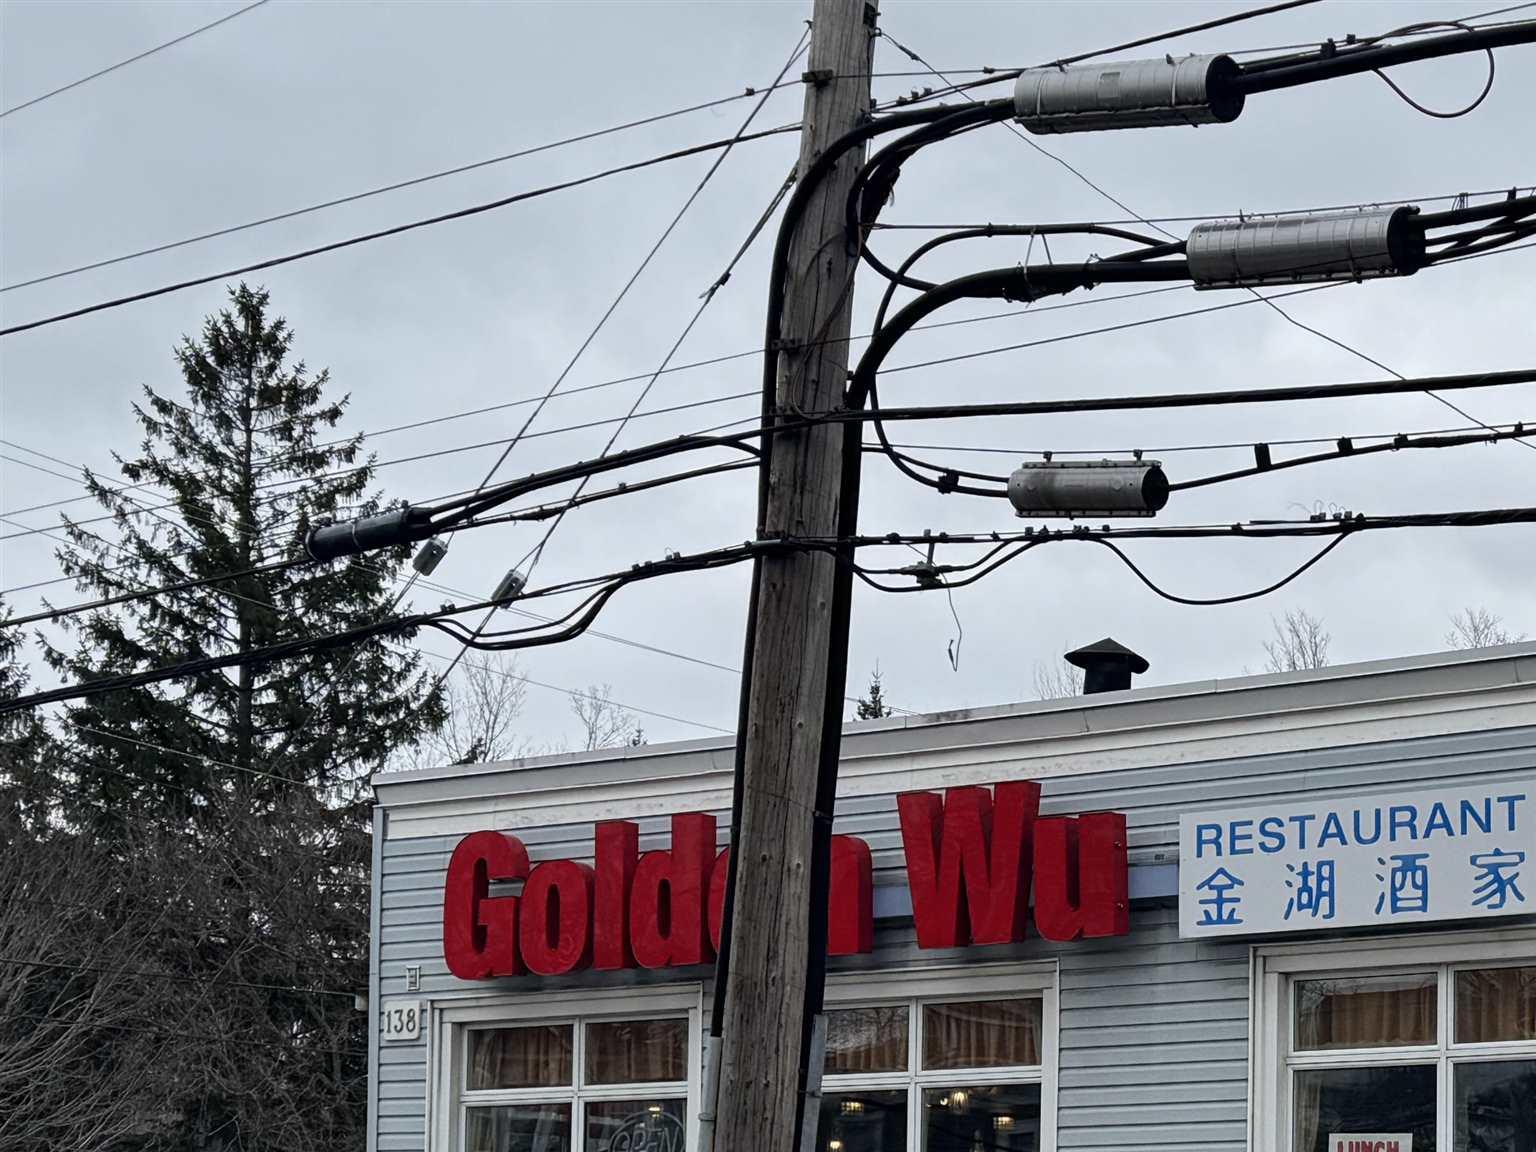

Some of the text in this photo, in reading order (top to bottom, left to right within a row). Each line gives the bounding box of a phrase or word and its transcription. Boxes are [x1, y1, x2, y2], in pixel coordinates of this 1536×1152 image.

[1195, 793, 1526, 859] RESTAURANT
[443, 780, 1129, 980] Goldn Wu
[1195, 847, 1526, 927] 金湖酒家
[385, 1008, 417, 1034] 138
